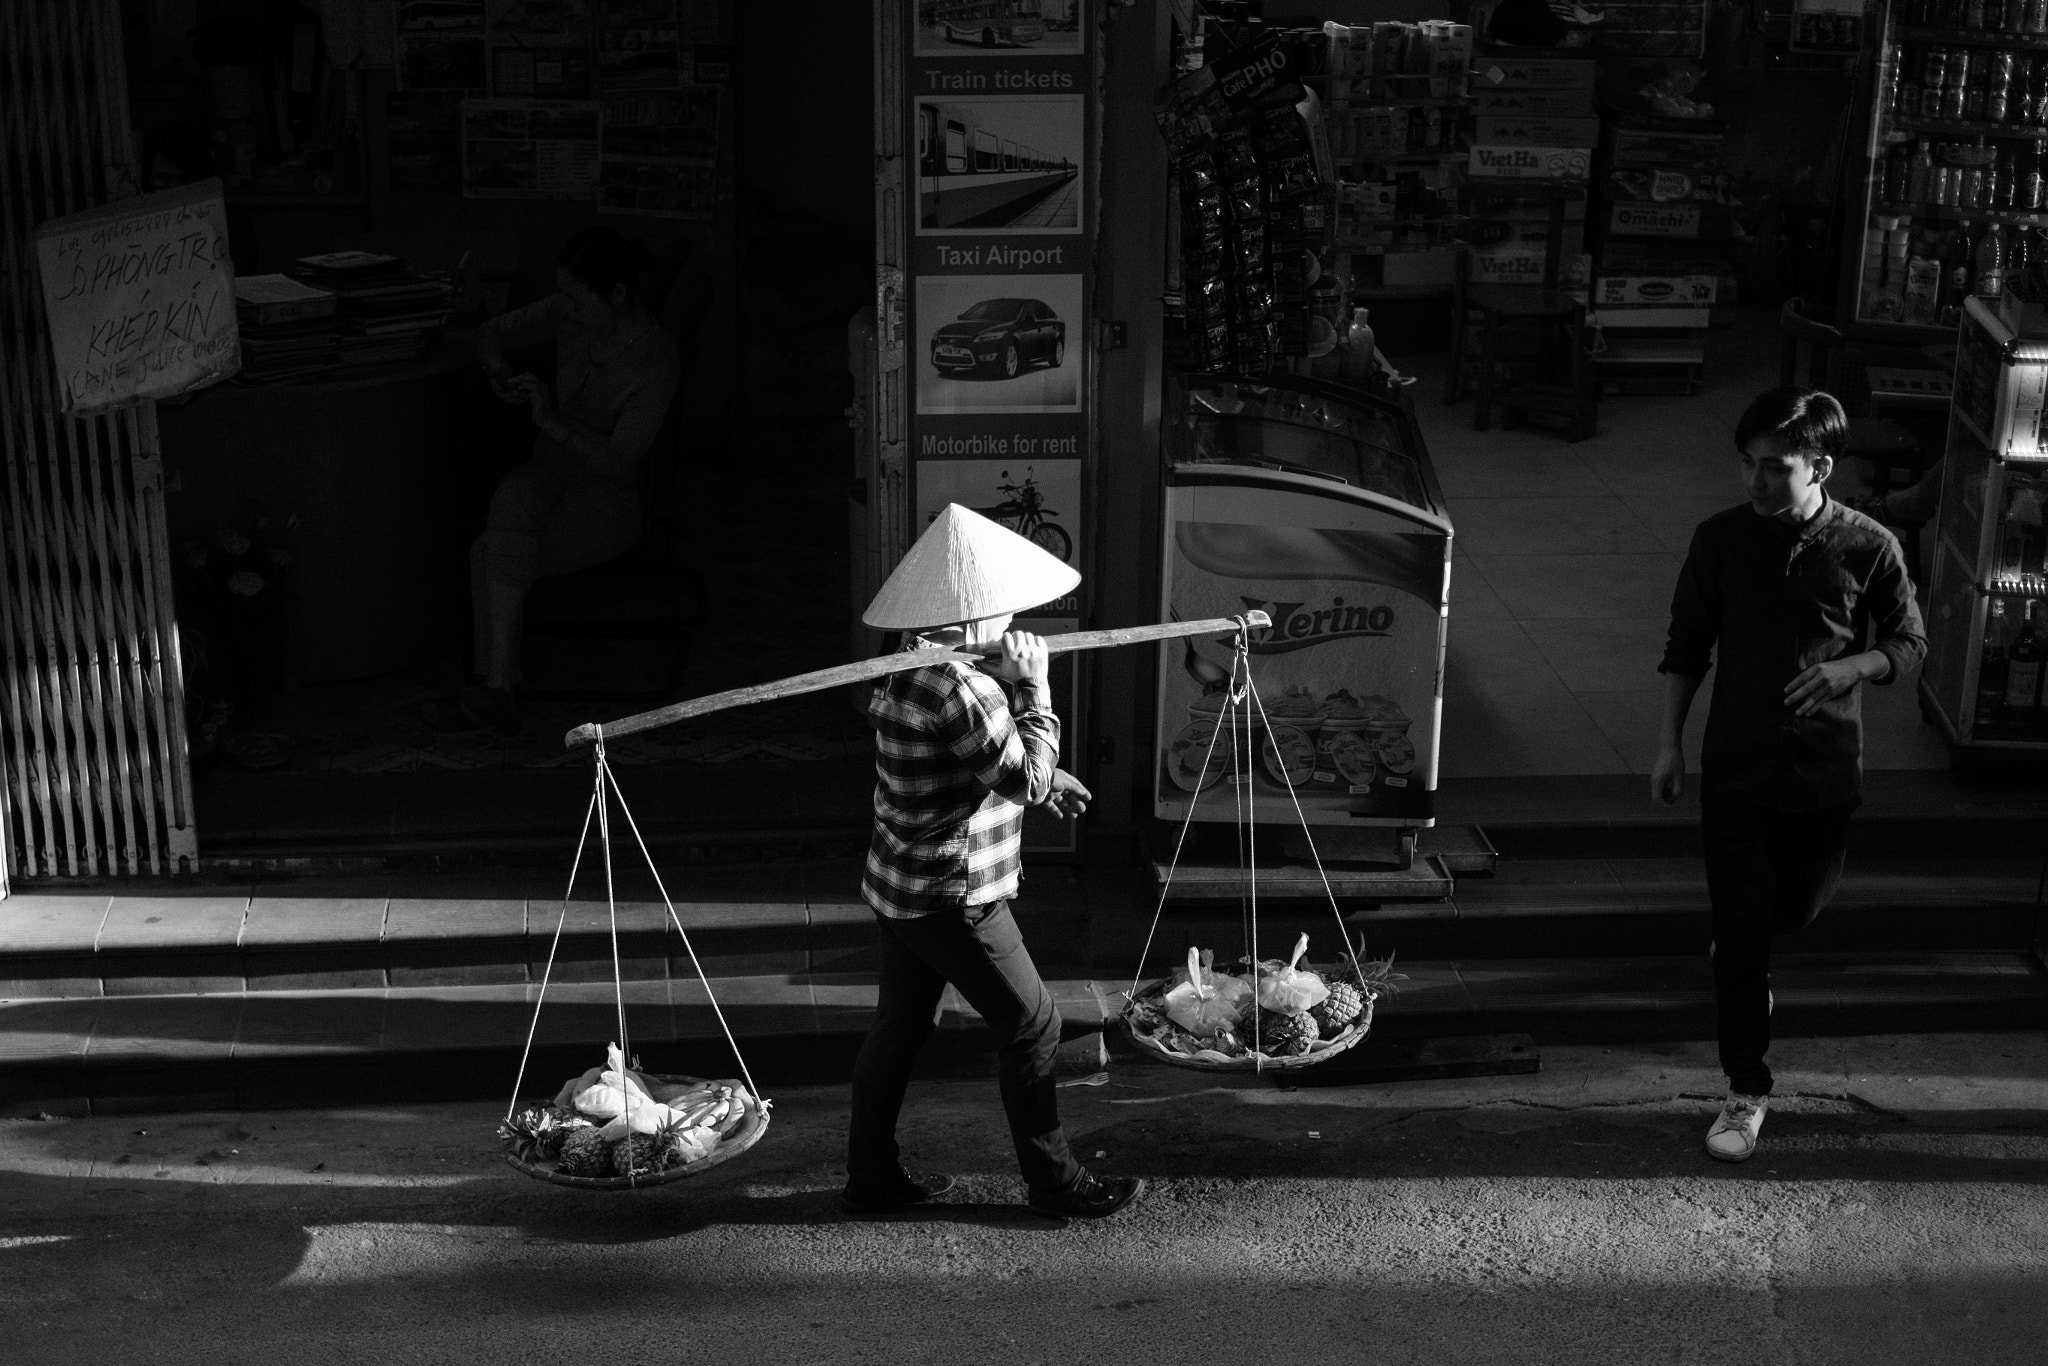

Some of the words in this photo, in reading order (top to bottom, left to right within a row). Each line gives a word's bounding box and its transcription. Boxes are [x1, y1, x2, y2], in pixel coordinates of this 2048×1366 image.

[925, 70, 986, 89] Train
[993, 69, 1073, 88] tickets
[936, 245, 981, 265] Taxi
[985, 245, 1063, 269] Airport
[922, 434, 1008, 455] Motorbike
[1013, 433, 1038, 454] for
[1042, 434, 1077, 454] rent
[1240, 596, 1395, 642] Merino
